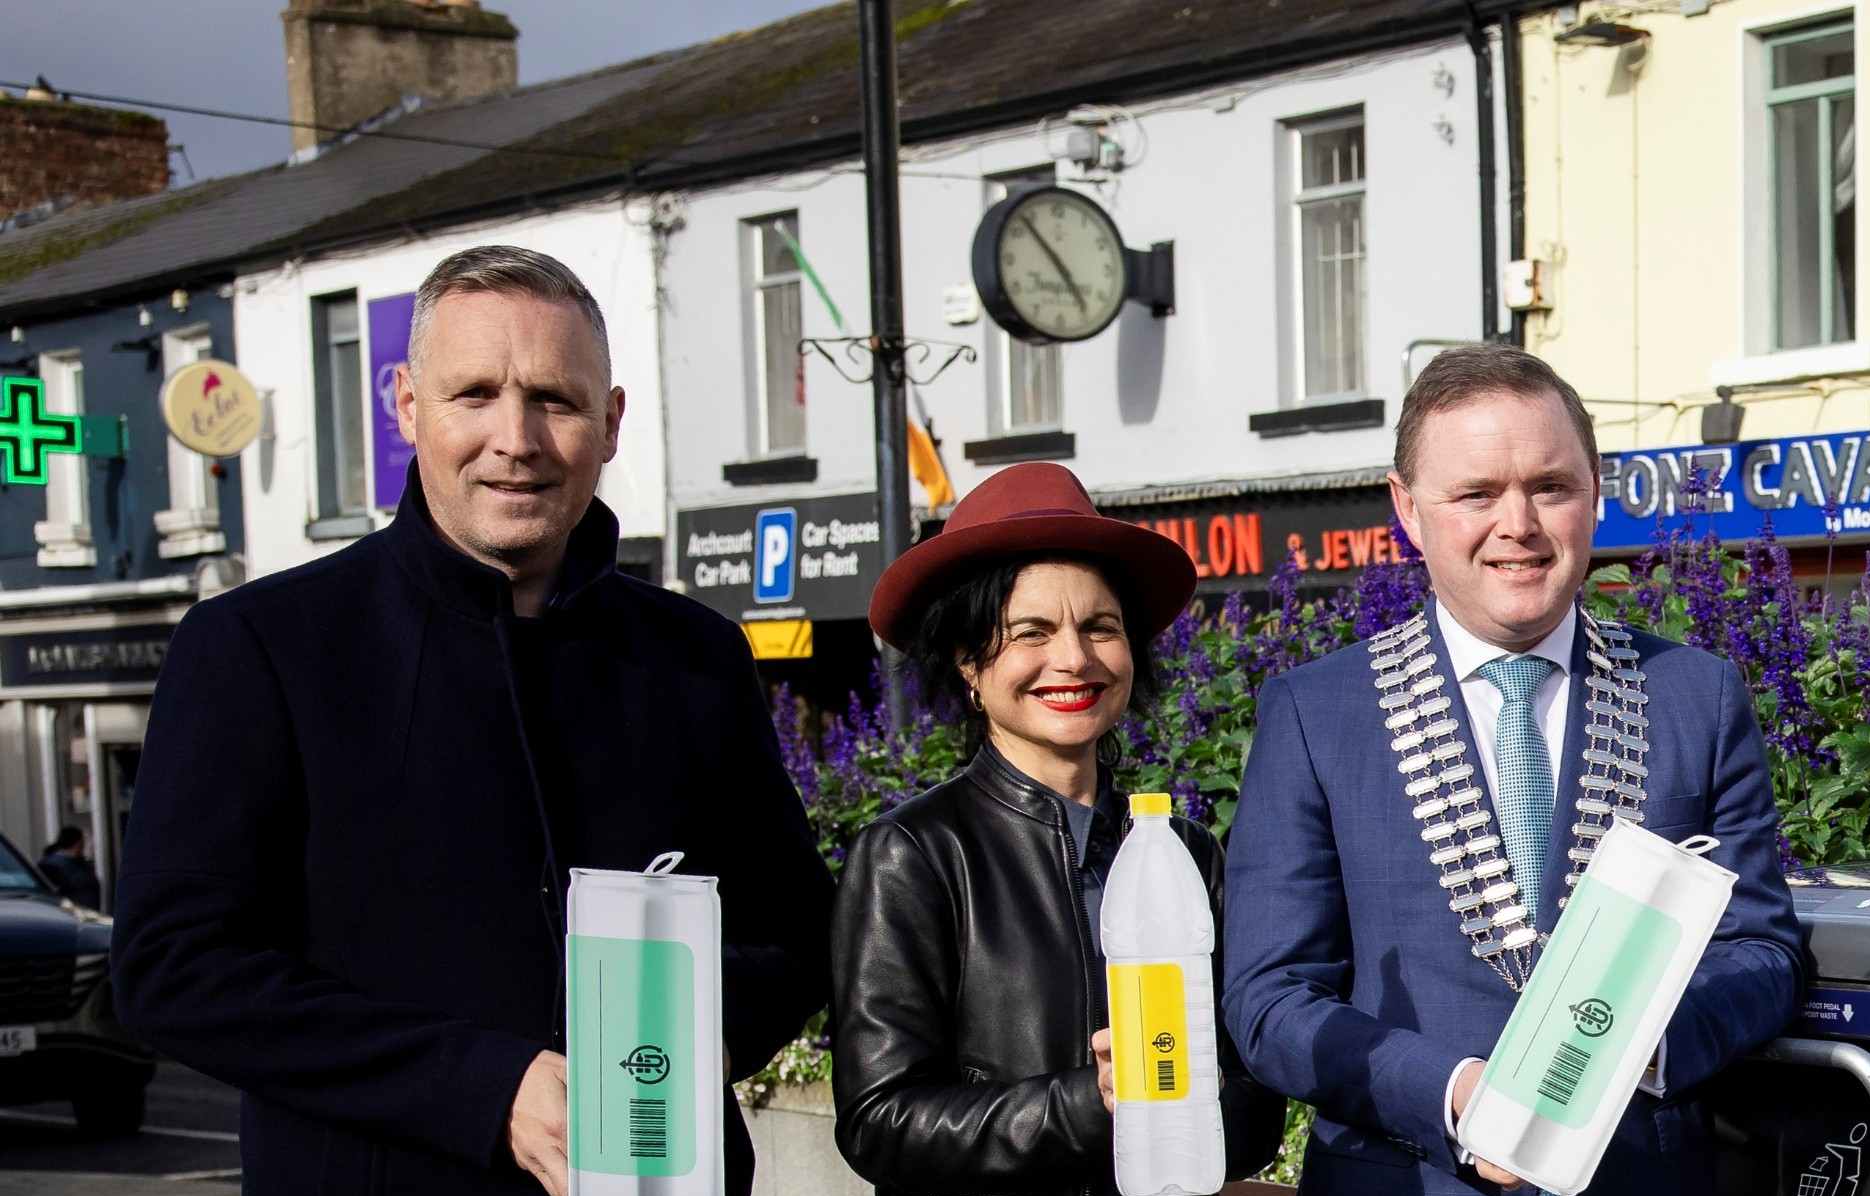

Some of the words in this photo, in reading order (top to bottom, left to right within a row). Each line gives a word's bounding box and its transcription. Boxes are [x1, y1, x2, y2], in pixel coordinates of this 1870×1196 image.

[1598, 448, 1733, 520] FONZ
[802, 521, 828, 548] Car
[762, 524, 789, 587] P
[801, 553, 822, 578] for
[822, 551, 859, 577] Rent
[695, 562, 719, 587] Car
[719, 559, 752, 585] Park
